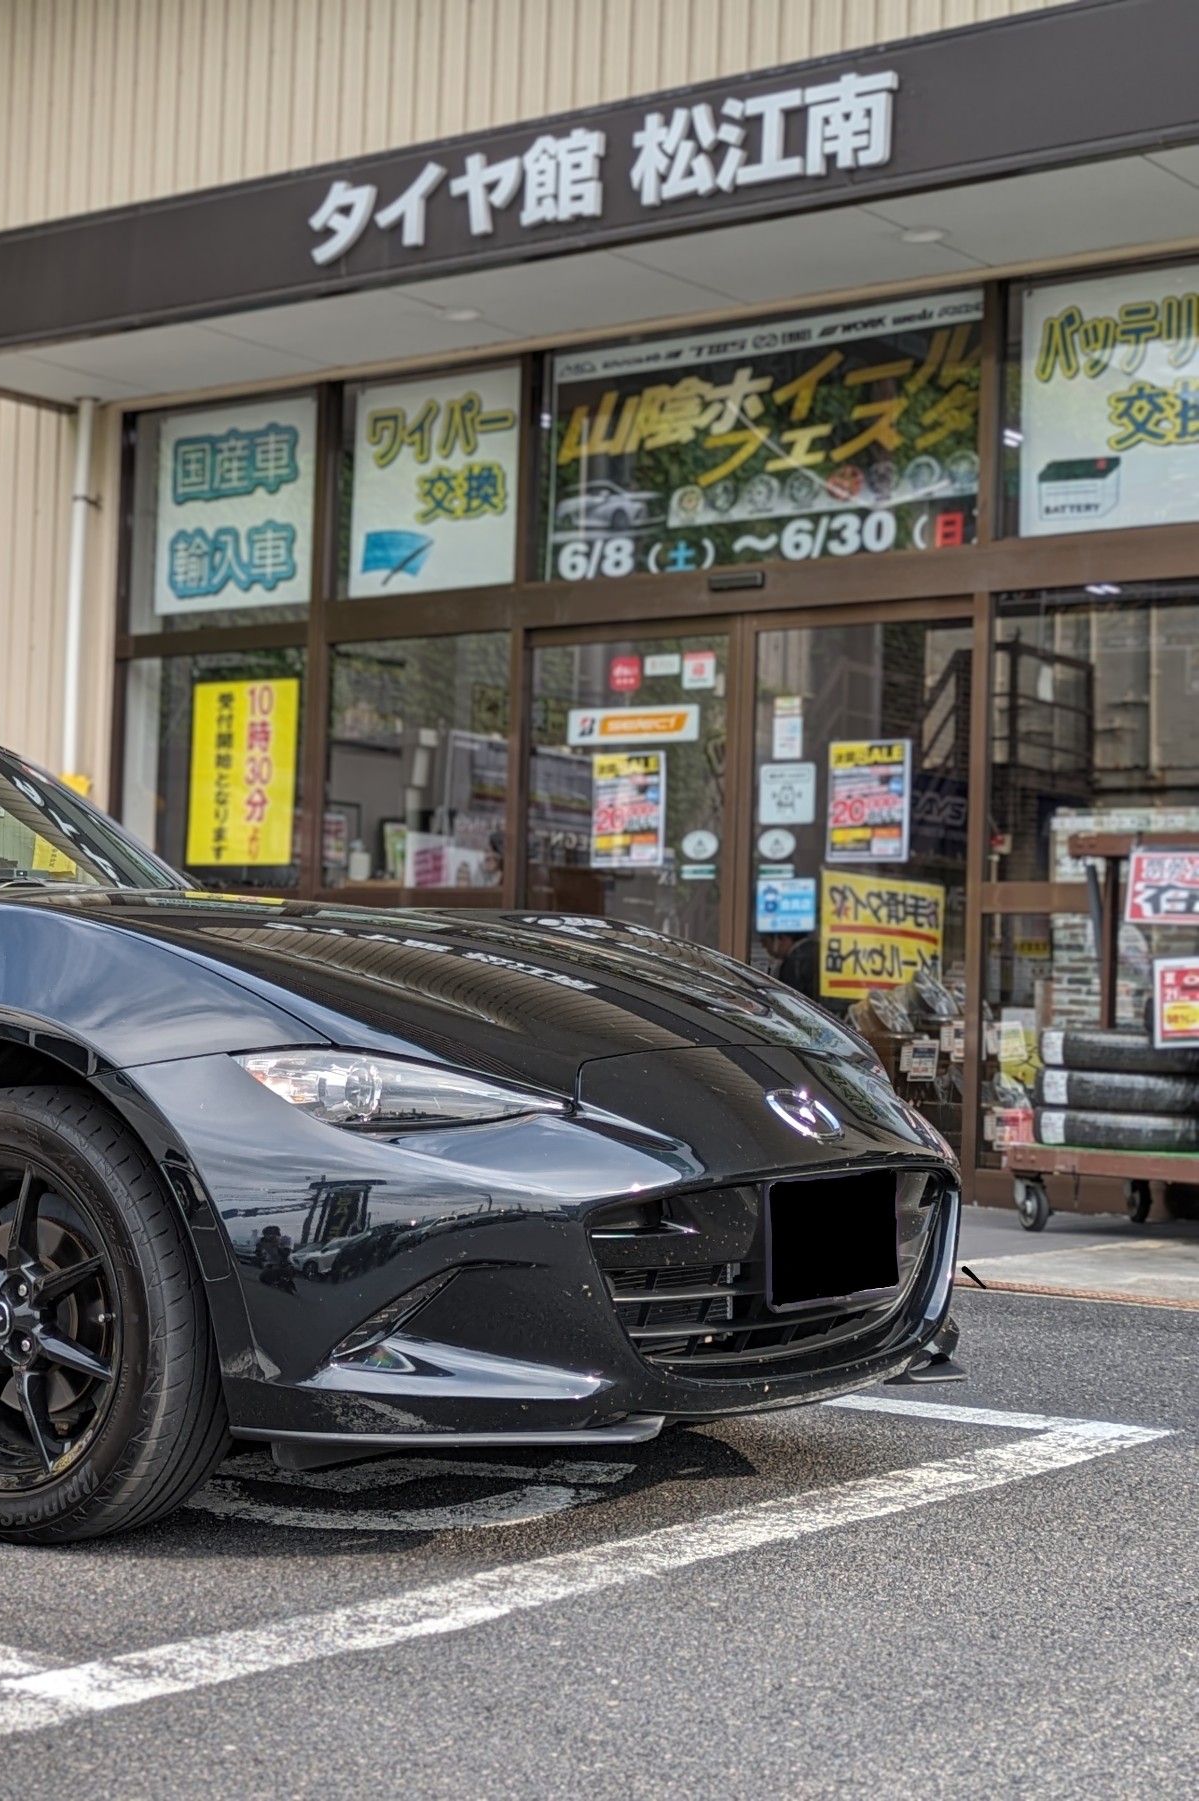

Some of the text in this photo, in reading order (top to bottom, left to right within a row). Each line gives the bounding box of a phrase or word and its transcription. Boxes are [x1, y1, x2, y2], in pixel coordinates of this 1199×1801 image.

[308, 69, 900, 266] タイヤ館 松江南
[174, 425, 297, 501] 国産車
[367, 391, 515, 467] ワイパー
[416, 461, 507, 523] 交換
[1044, 502, 1100, 515] BATTERY
[170, 522, 296, 595] 輸入車
